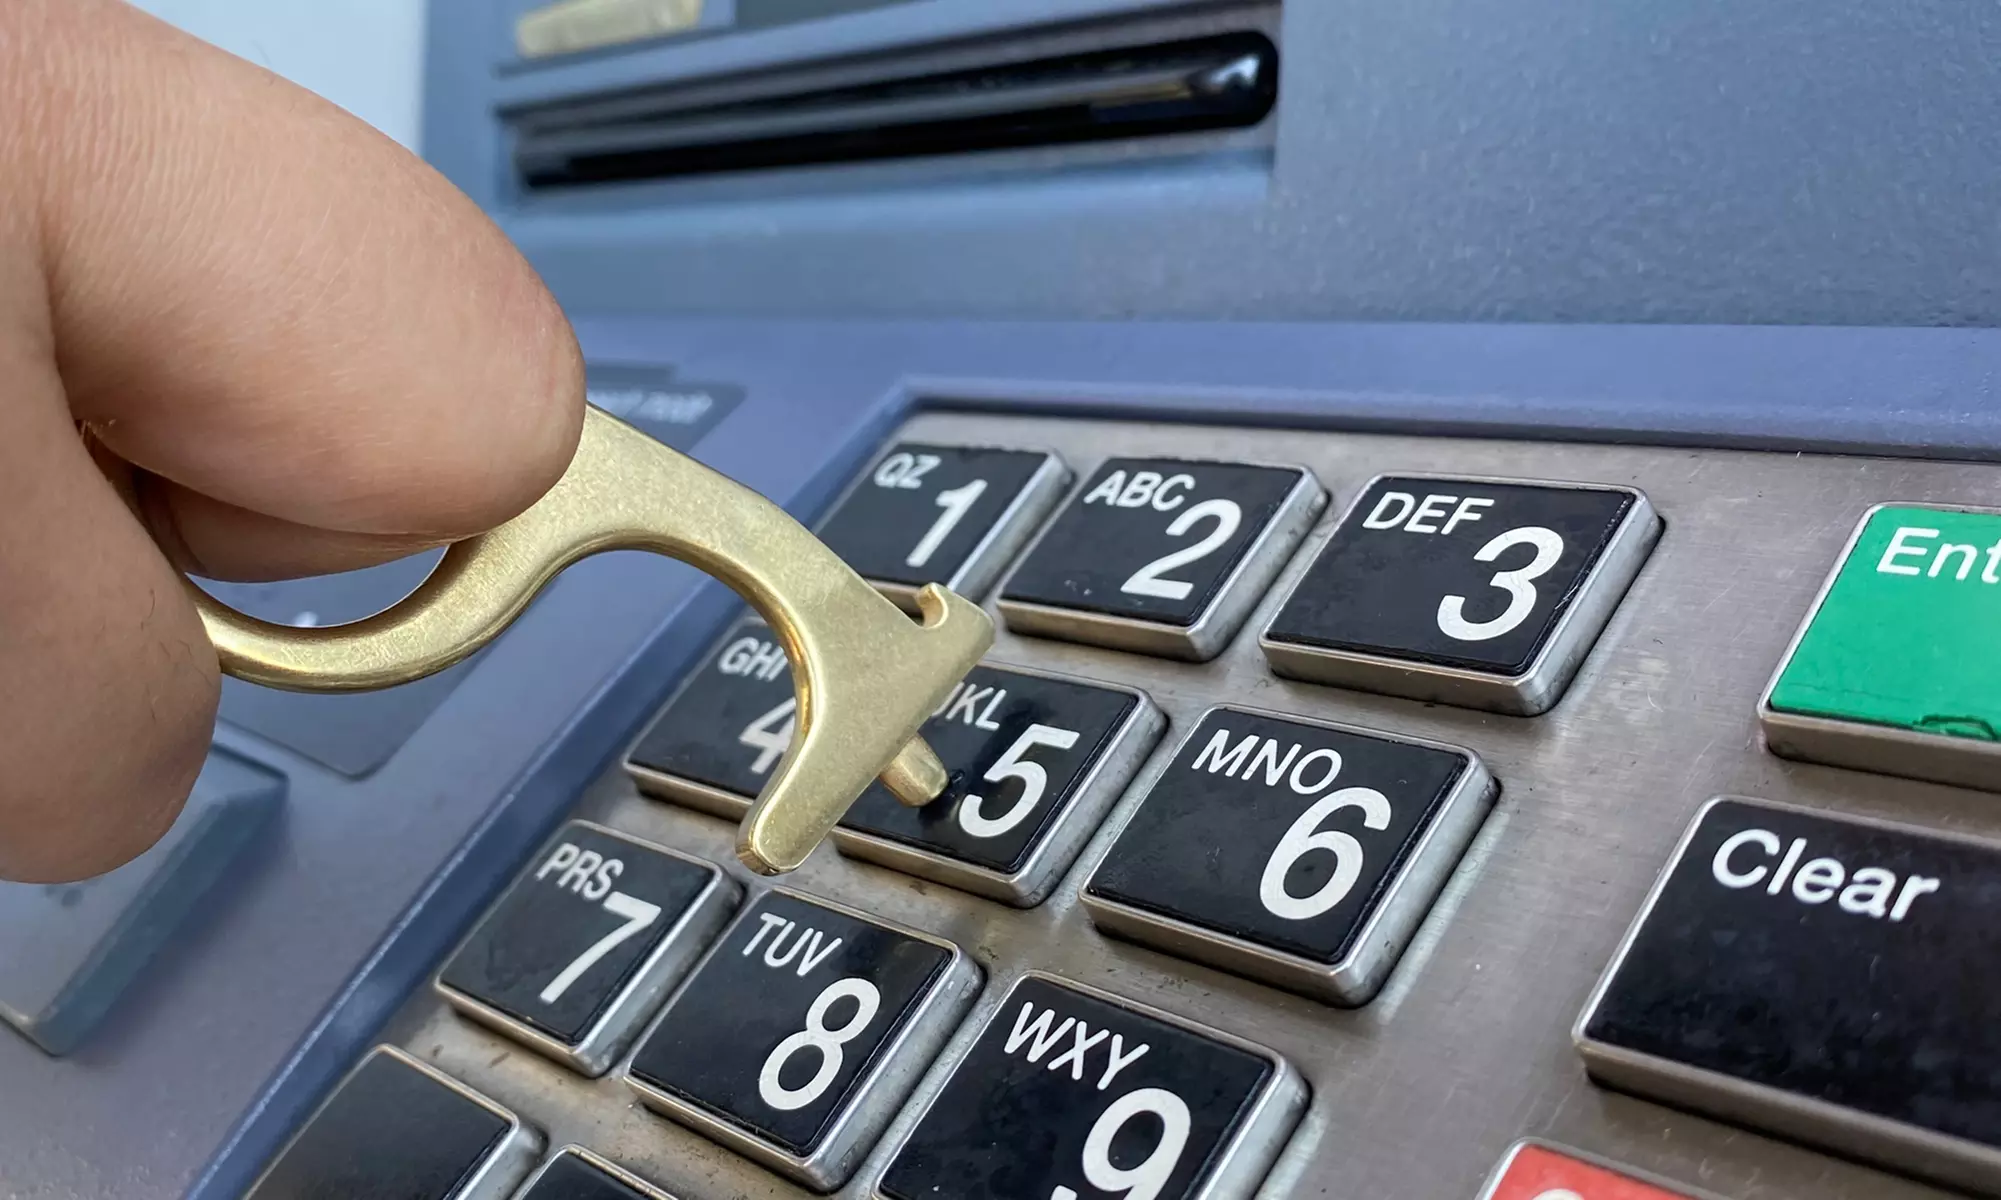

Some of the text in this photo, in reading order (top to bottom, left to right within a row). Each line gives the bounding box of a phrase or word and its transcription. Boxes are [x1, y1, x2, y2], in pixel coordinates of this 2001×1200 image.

[874, 452, 942, 489] QZ
[1083, 470, 1195, 512] ABC
[1362, 491, 1495, 535] DEF
[907, 479, 987, 567] 1
[1120, 499, 1242, 600] 2
[1436, 526, 1564, 641] 3
[738, 696, 796, 775] 4
[958, 723, 1081, 838] 5
[1191, 728, 1342, 795] MNO
[535, 842, 624, 900] PRS
[1259, 787, 1392, 920] 6
[1712, 829, 1940, 920] Clear
[539, 891, 662, 1004] 7
[742, 912, 843, 977] TUV
[758, 977, 881, 1111] 8
[1003, 1001, 1150, 1091] WXY
[1050, 1088, 1191, 1200] 9
